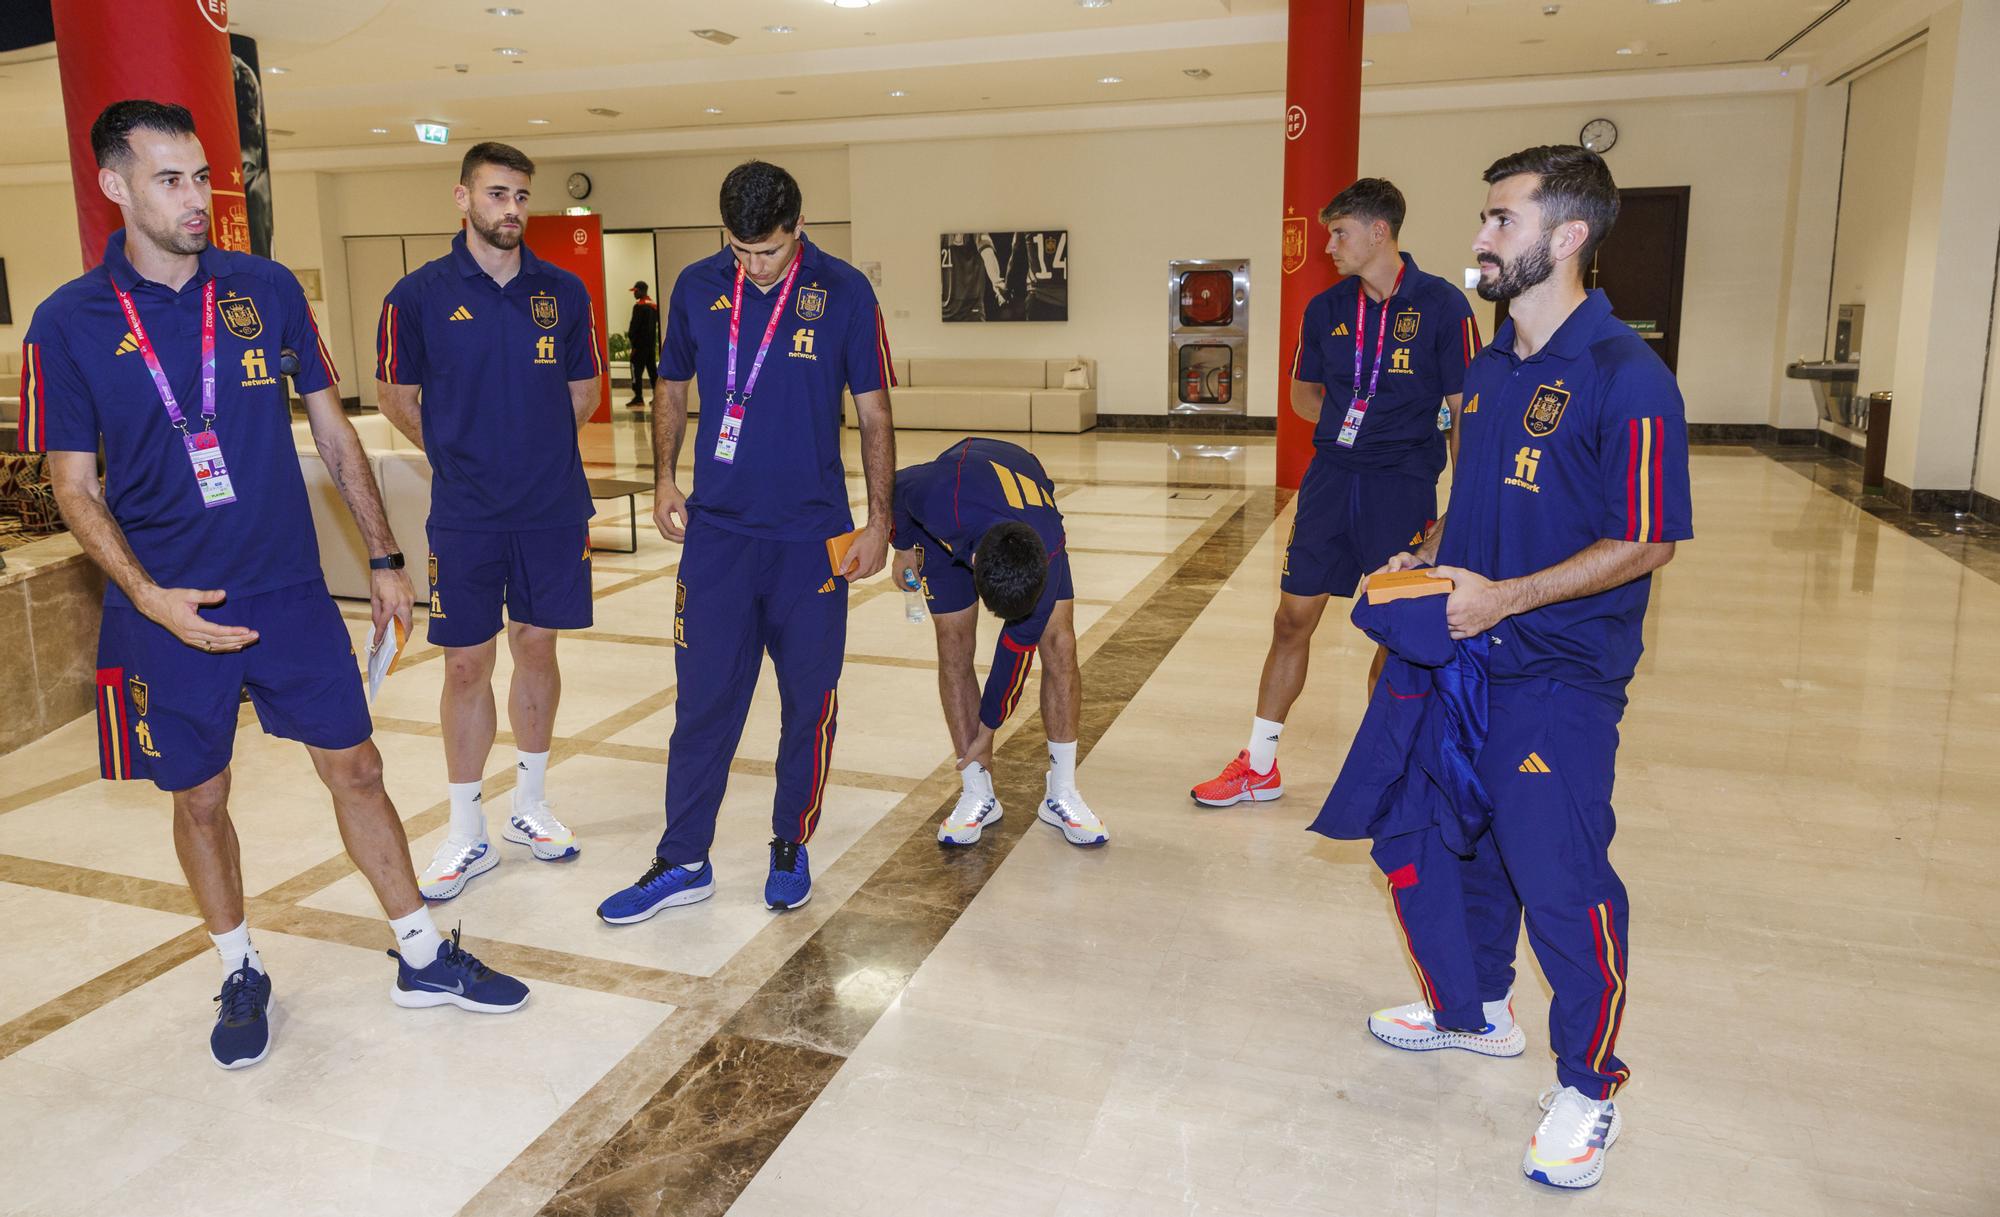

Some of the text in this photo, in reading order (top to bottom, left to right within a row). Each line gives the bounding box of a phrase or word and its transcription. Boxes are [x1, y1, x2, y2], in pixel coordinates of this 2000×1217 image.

[941, 248, 952, 268] 21
[1033, 233, 1066, 280] 14
[536, 336, 554, 358] fi
[792, 328, 814, 353] fi
[241, 349, 268, 379] fi
[788, 352, 817, 360] network
[1392, 348, 1410, 368] fi
[241, 377, 276, 387] network
[1514, 447, 1542, 483] fi
[1504, 477, 1540, 493] network
[135, 720, 154, 750] fi
